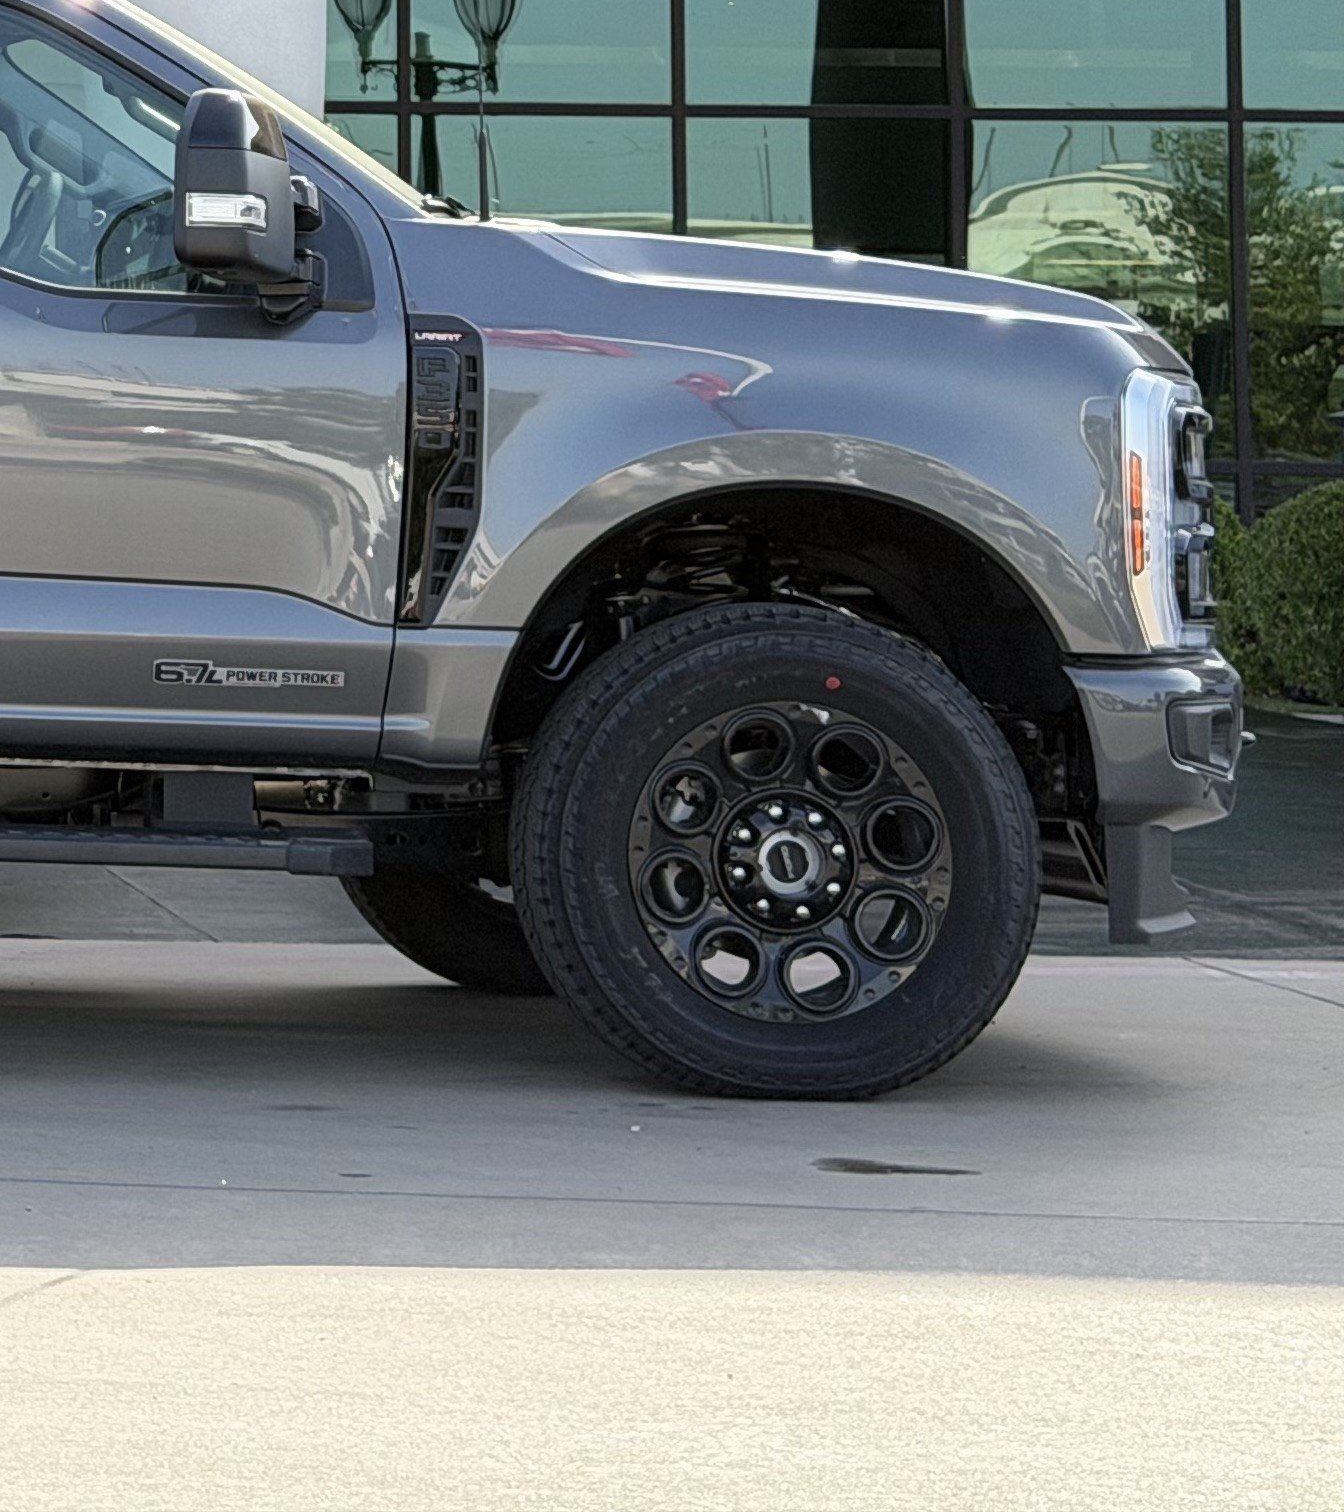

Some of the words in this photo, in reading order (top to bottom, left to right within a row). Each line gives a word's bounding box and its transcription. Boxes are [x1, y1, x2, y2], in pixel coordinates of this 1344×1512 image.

[153, 660, 223, 684] 6.7L
[226, 669, 278, 684] POWER
[281, 671, 341, 685] STROKE
